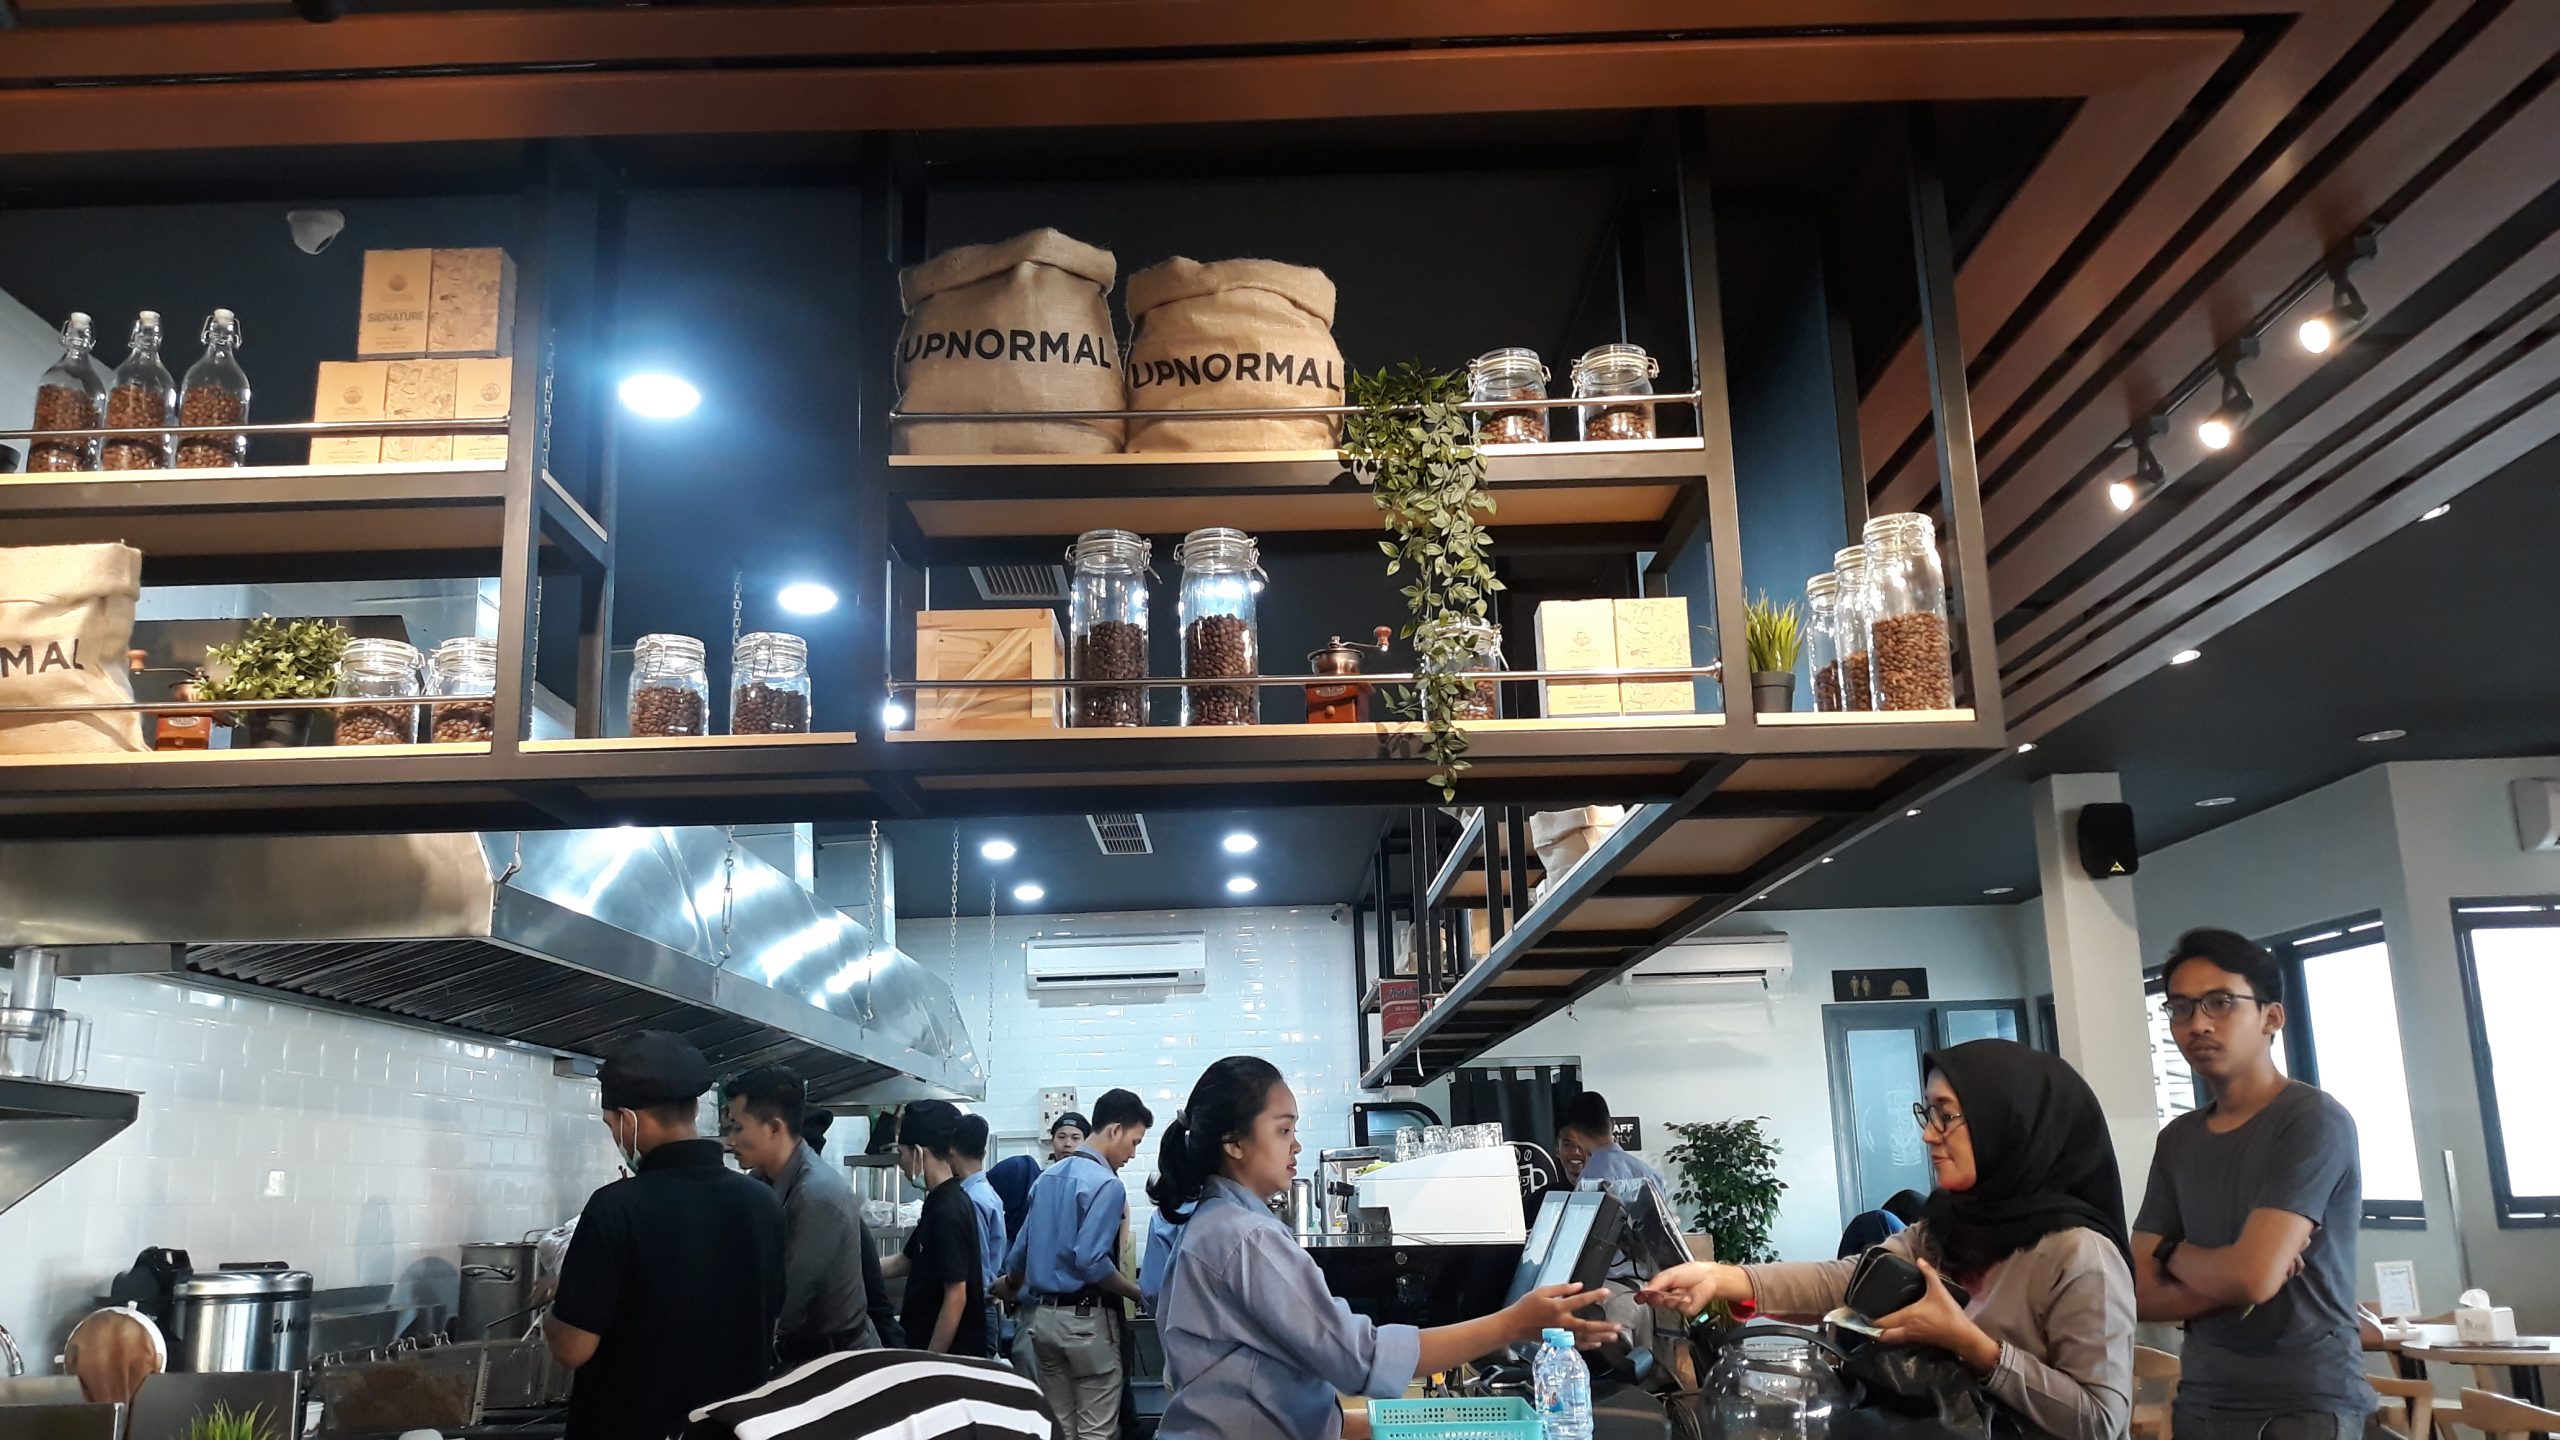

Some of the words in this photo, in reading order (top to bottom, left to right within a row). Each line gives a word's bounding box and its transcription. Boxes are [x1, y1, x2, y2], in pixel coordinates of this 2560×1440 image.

[367, 310, 425, 323] SIGNATURE
[902, 328, 1112, 369] UPNORMAL
[1131, 352, 1341, 393] UPNORMAL
[1612, 1123, 1634, 1134] AFF
[1614, 1134, 1633, 1144] NLY
